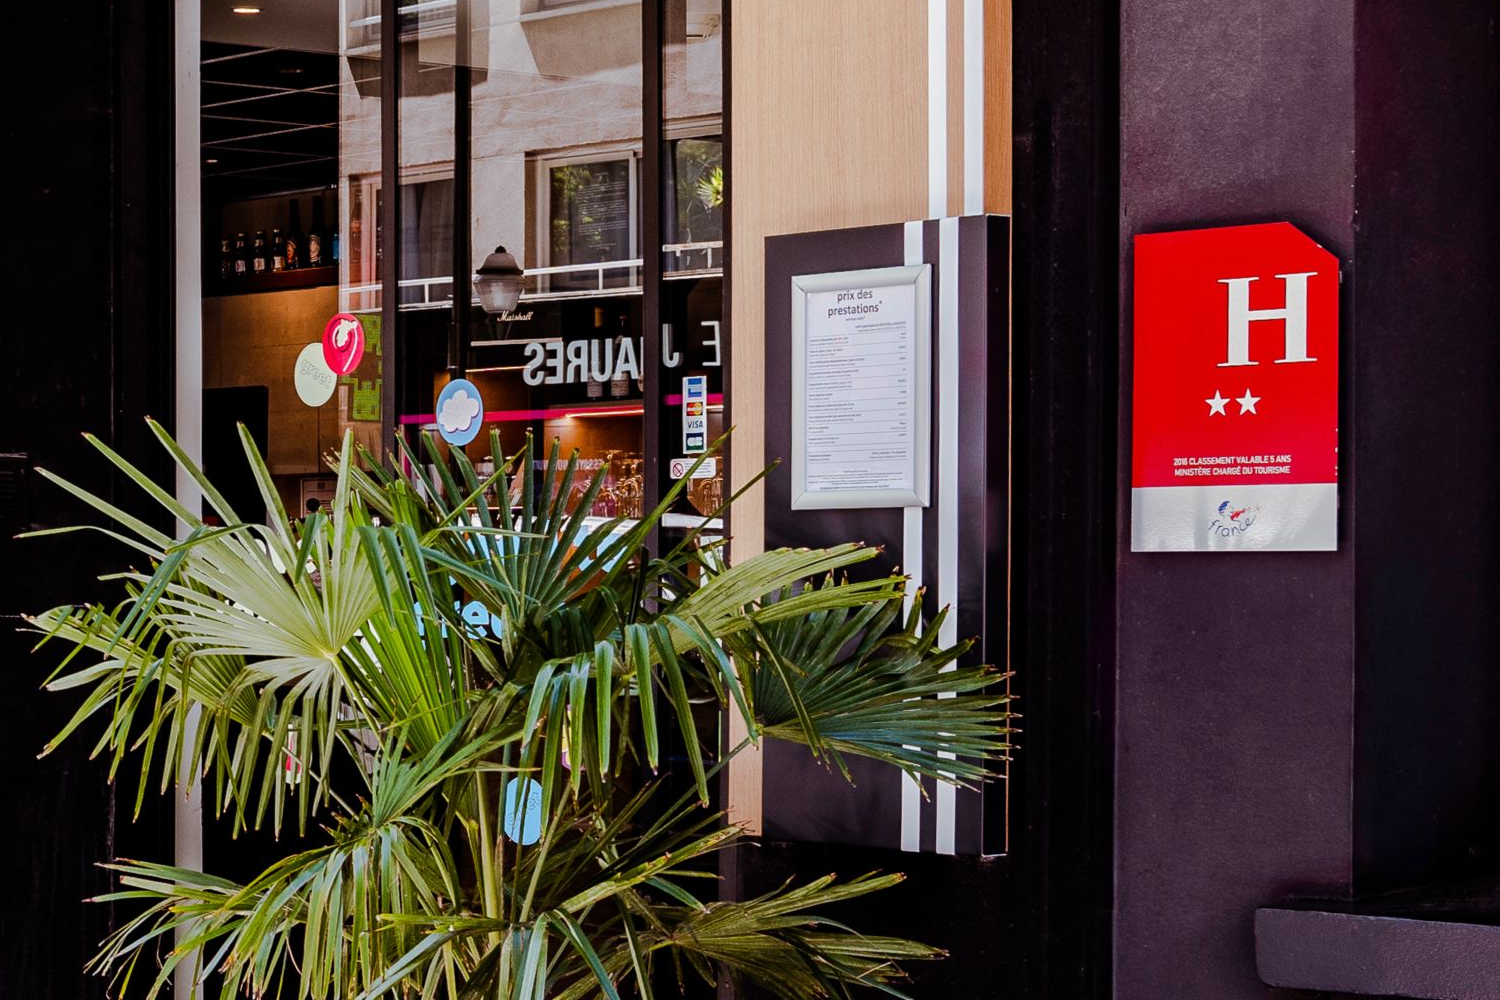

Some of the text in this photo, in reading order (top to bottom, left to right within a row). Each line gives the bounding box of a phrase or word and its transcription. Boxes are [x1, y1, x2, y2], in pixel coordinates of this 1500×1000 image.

[837, 289, 873, 304] prix des
[497, 310, 534, 322] Marshall
[1217, 271, 1318, 367] H
[687, 420, 704, 429] VISA
[1189, 456, 1235, 466] CLASSEMENT
[1236, 455, 1269, 464] VALABLE
[1269, 455, 1275, 463] 5
[1275, 454, 1292, 463] ANS
[1174, 465, 1291, 476] MINISTÈRE CHARGÉ DU TOURISME
[1208, 514, 1257, 537] france
